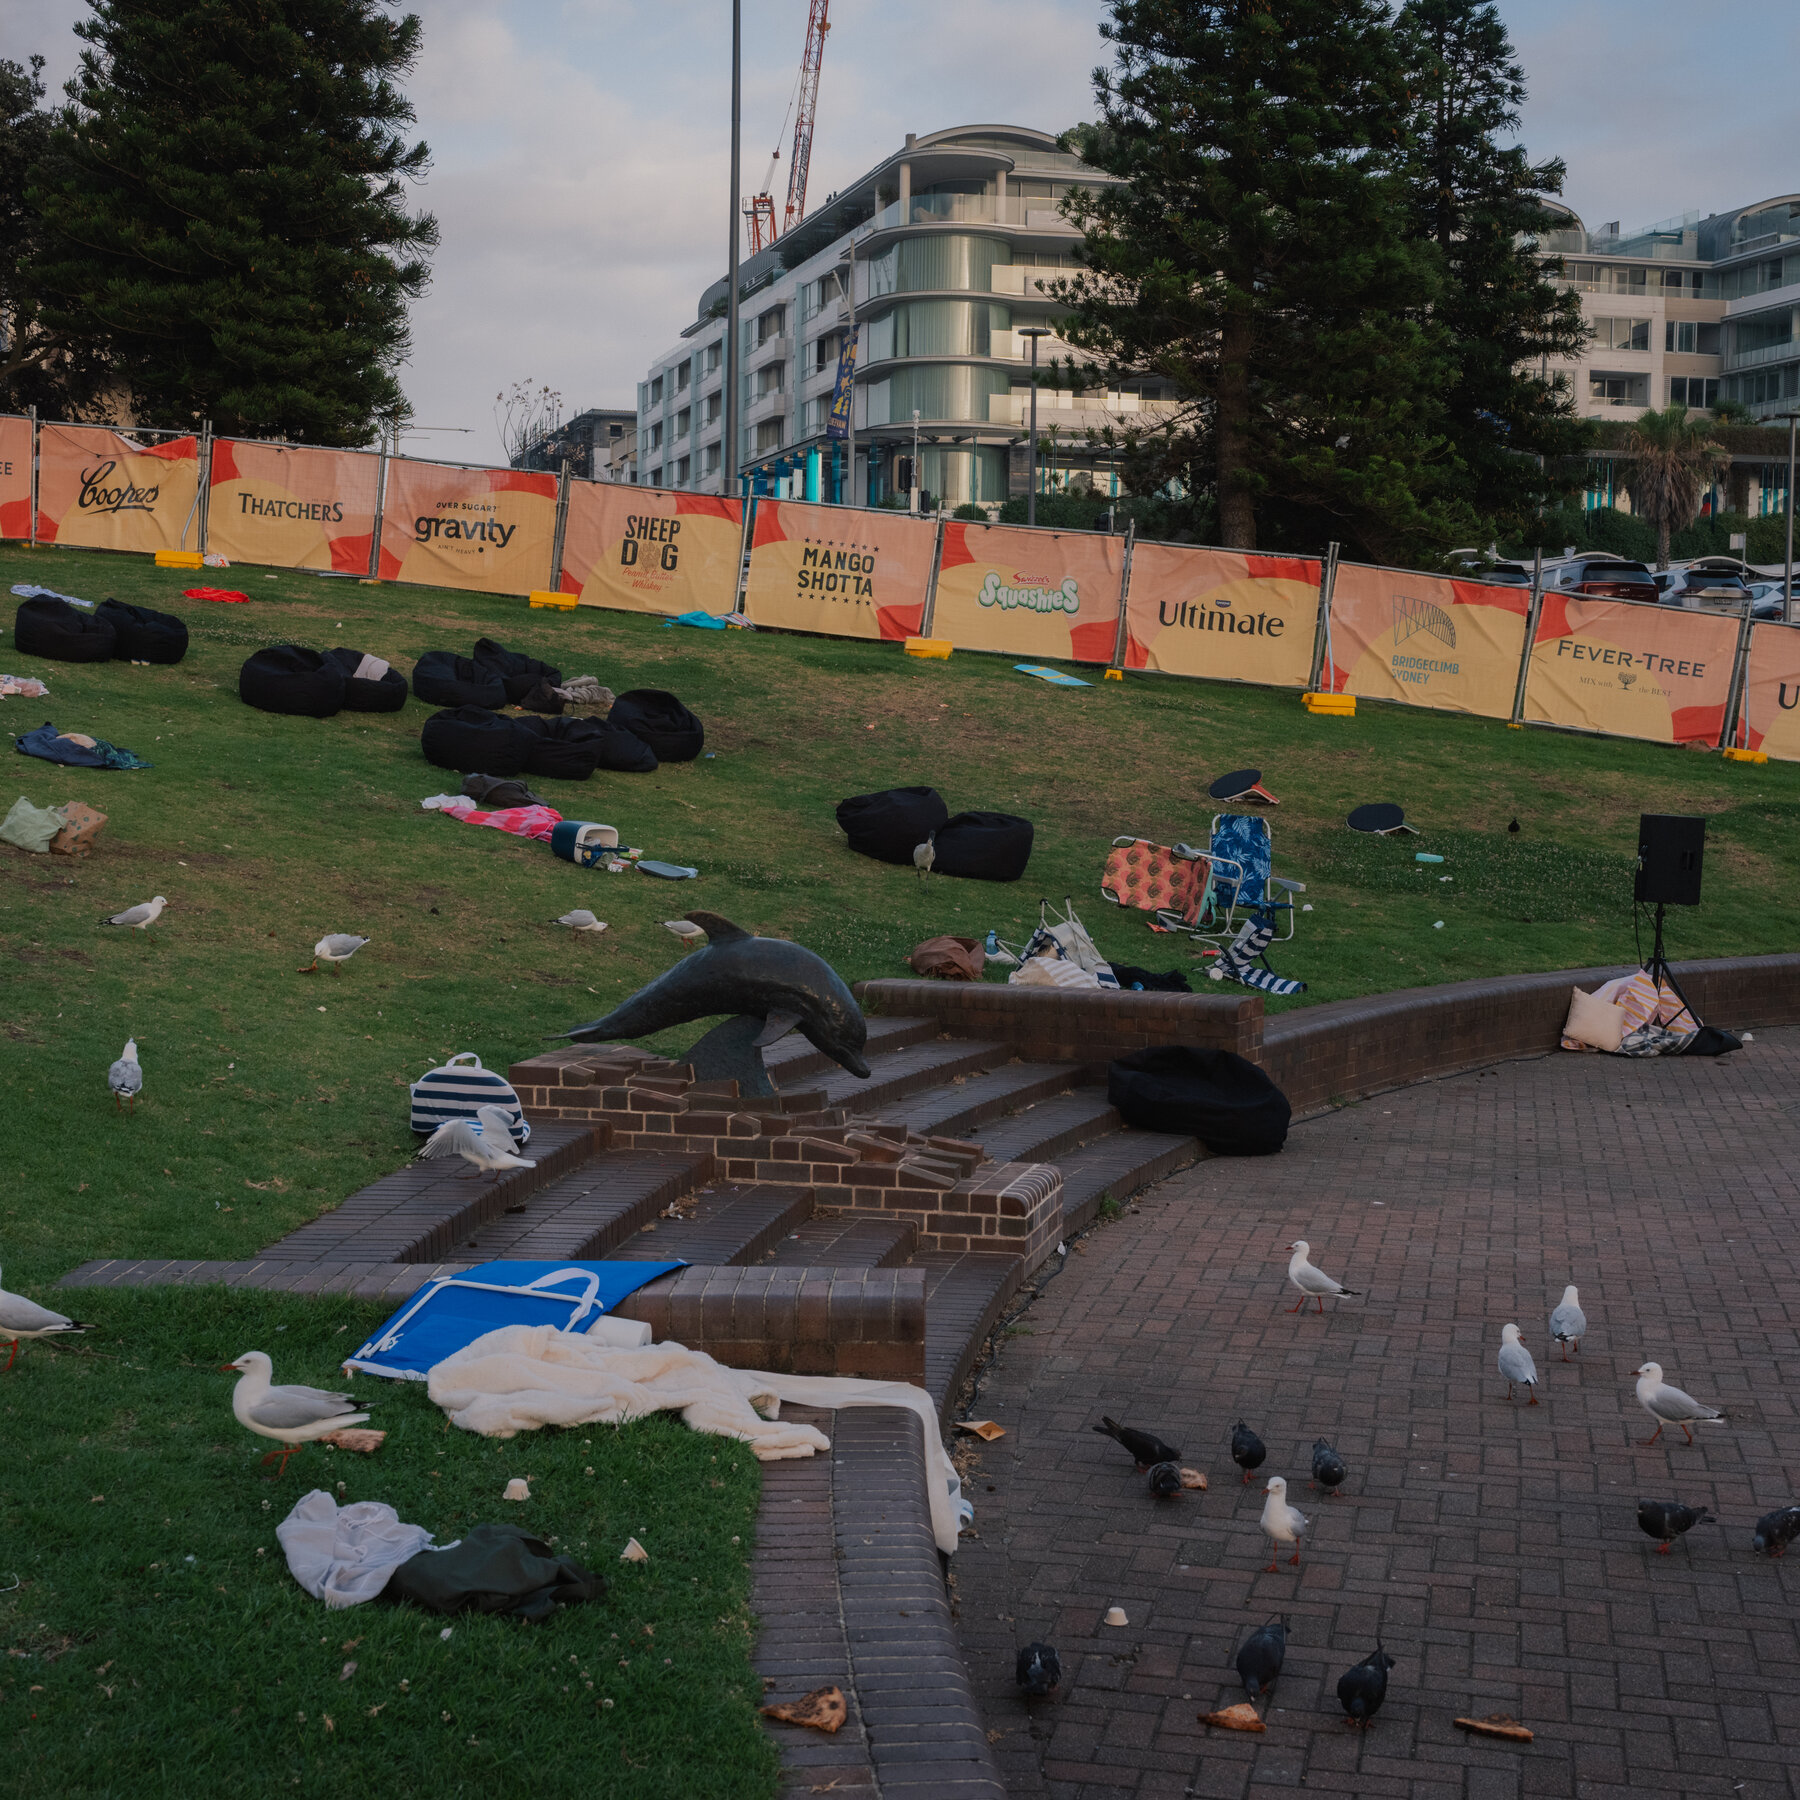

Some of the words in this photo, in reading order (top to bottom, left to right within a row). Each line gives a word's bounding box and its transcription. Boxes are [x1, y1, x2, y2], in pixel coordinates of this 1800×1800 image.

[78, 460, 159, 514] Coopers
[238, 492, 343, 522] THATCHERS
[436, 502, 459, 510] OVER
[462, 503, 497, 513] SUGAR?
[414, 516, 516, 548] gravity
[625, 515, 681, 543] SHEEP
[620, 539, 679, 571] DG
[802, 547, 875, 574] MANGO
[632, 579, 663, 593] Whiskey
[797, 570, 873, 597] SHOTTA
[1159, 600, 1285, 637] Ultimate
[1391, 654, 1460, 675] BRIDGECLIMB
[1556, 639, 1706, 678] FEVER-TREE
[1391, 668, 1430, 684] SYDNEY
[1579, 676, 1596, 686] MIX
[1597, 679, 1614, 688] with
[1651, 688, 1673, 697] BEST
